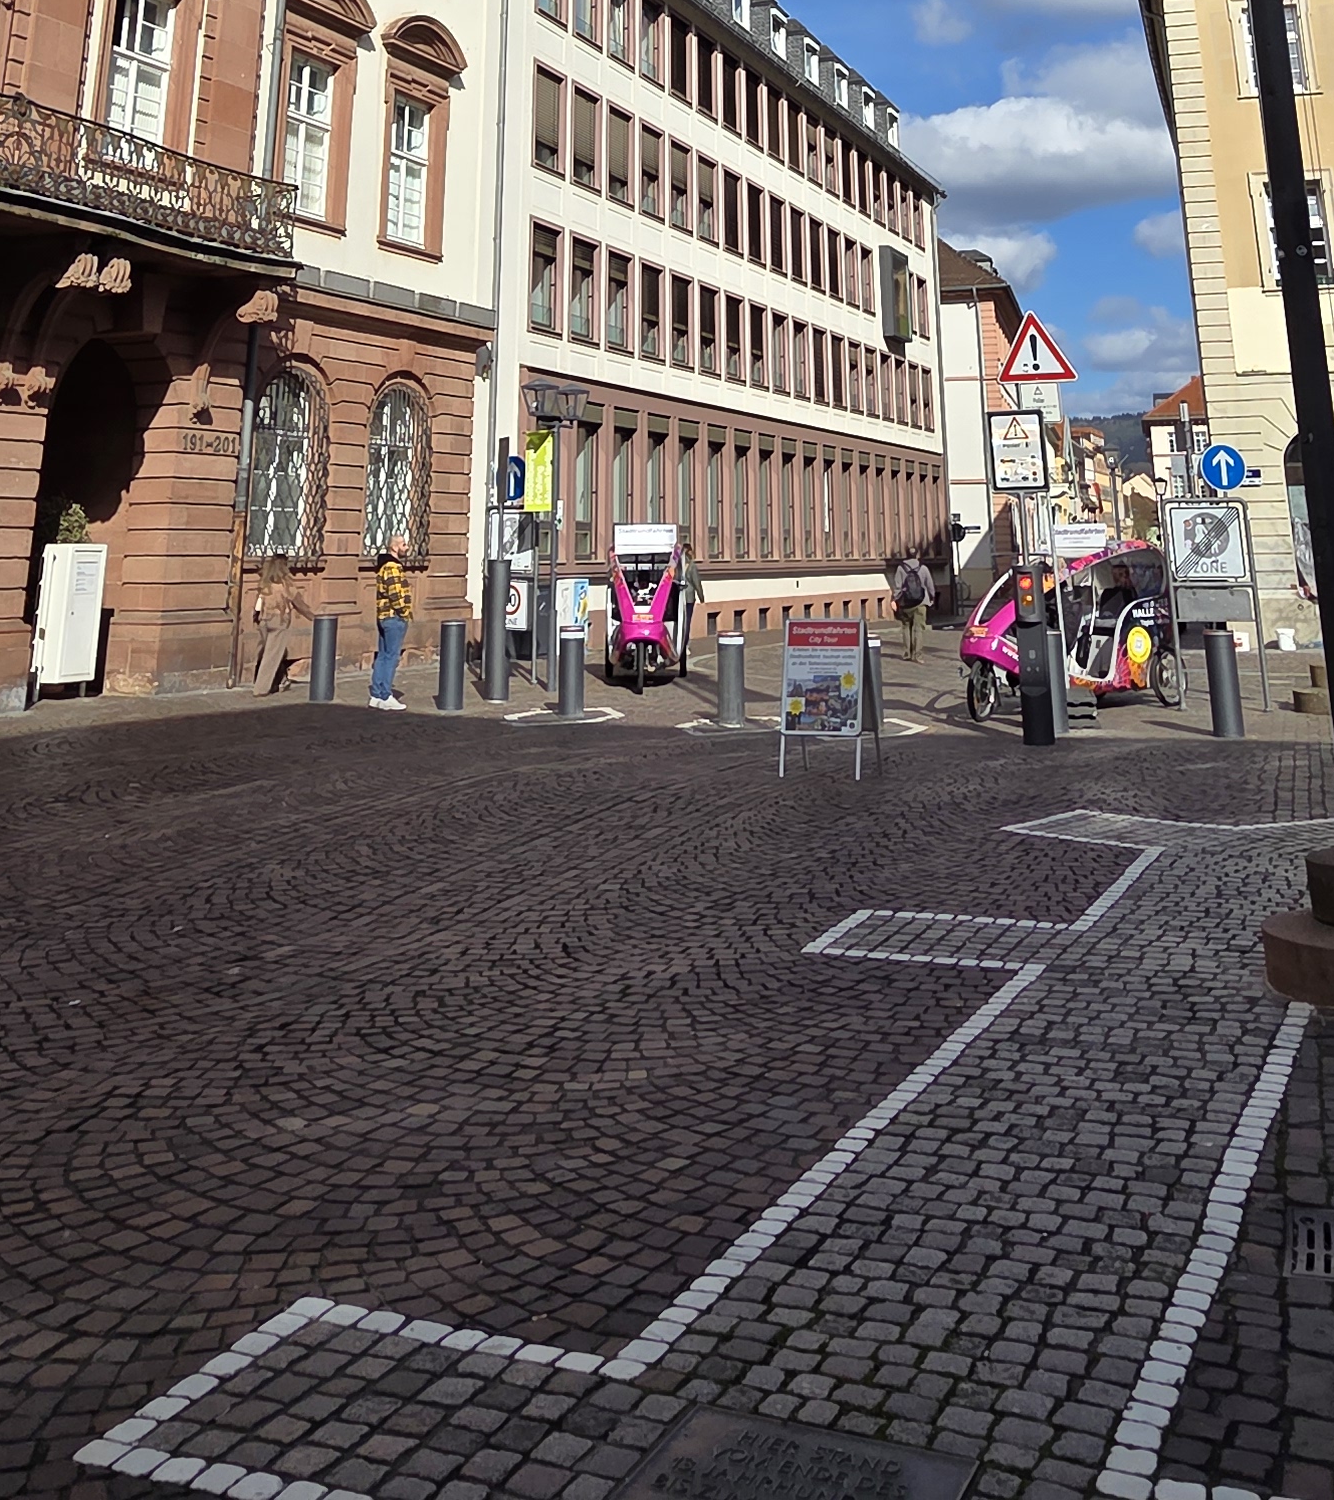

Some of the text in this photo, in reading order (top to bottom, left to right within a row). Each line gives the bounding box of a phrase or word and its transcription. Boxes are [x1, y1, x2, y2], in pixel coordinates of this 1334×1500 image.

[182, 432, 237, 454] 191-201
[1193, 561, 1229, 574] ZONE
[792, 626, 857, 635] Stadtrundfahrten
[809, 636, 822, 644] City
[737, 1429, 902, 1476] HIER STAND
[713, 1444, 909, 1499] VOM ENDE DES
